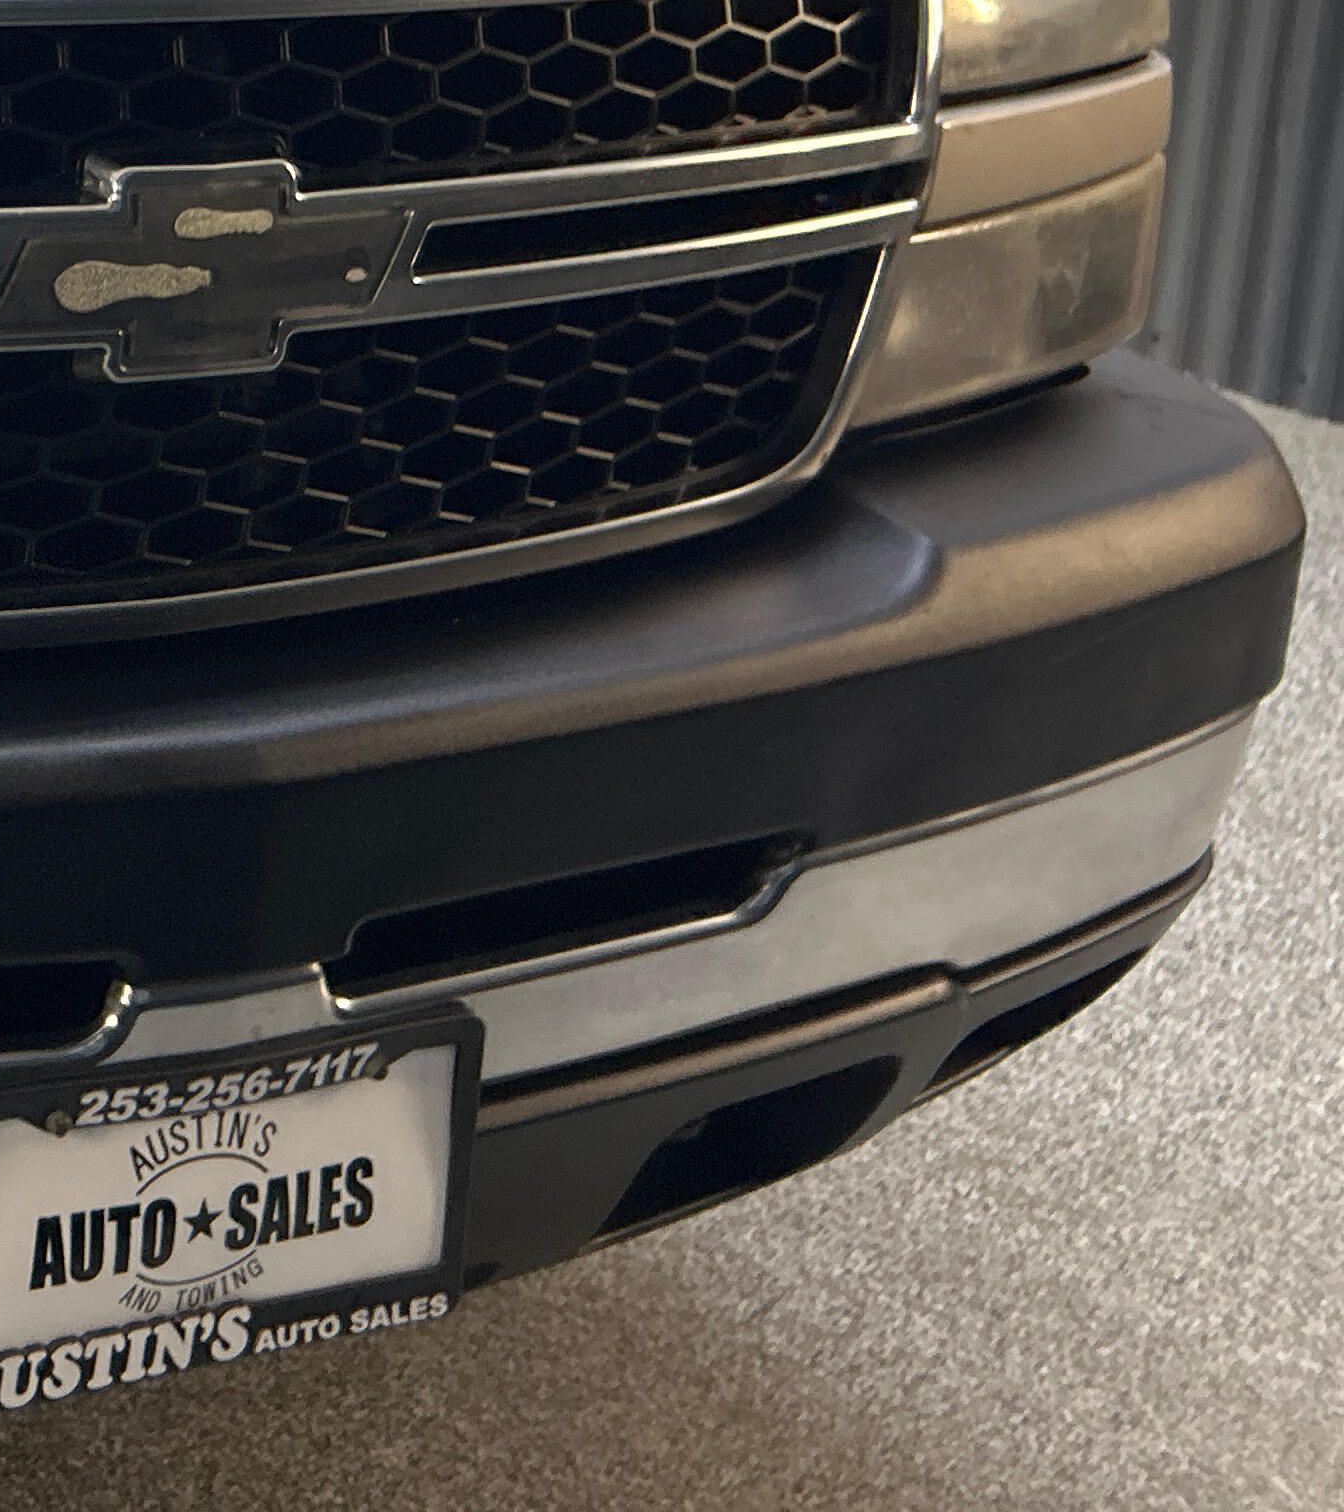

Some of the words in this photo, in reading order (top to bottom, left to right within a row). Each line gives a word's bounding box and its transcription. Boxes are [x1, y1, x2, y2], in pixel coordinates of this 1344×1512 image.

[77, 1044, 379, 1126] 253-256-7117
[128, 1110, 279, 1181] AUSTIN'S
[28, 1196, 179, 1290] AUTO
[223, 1155, 375, 1252] SALES
[254, 1311, 341, 1354] AUTO
[349, 1292, 450, 1335] SALES
